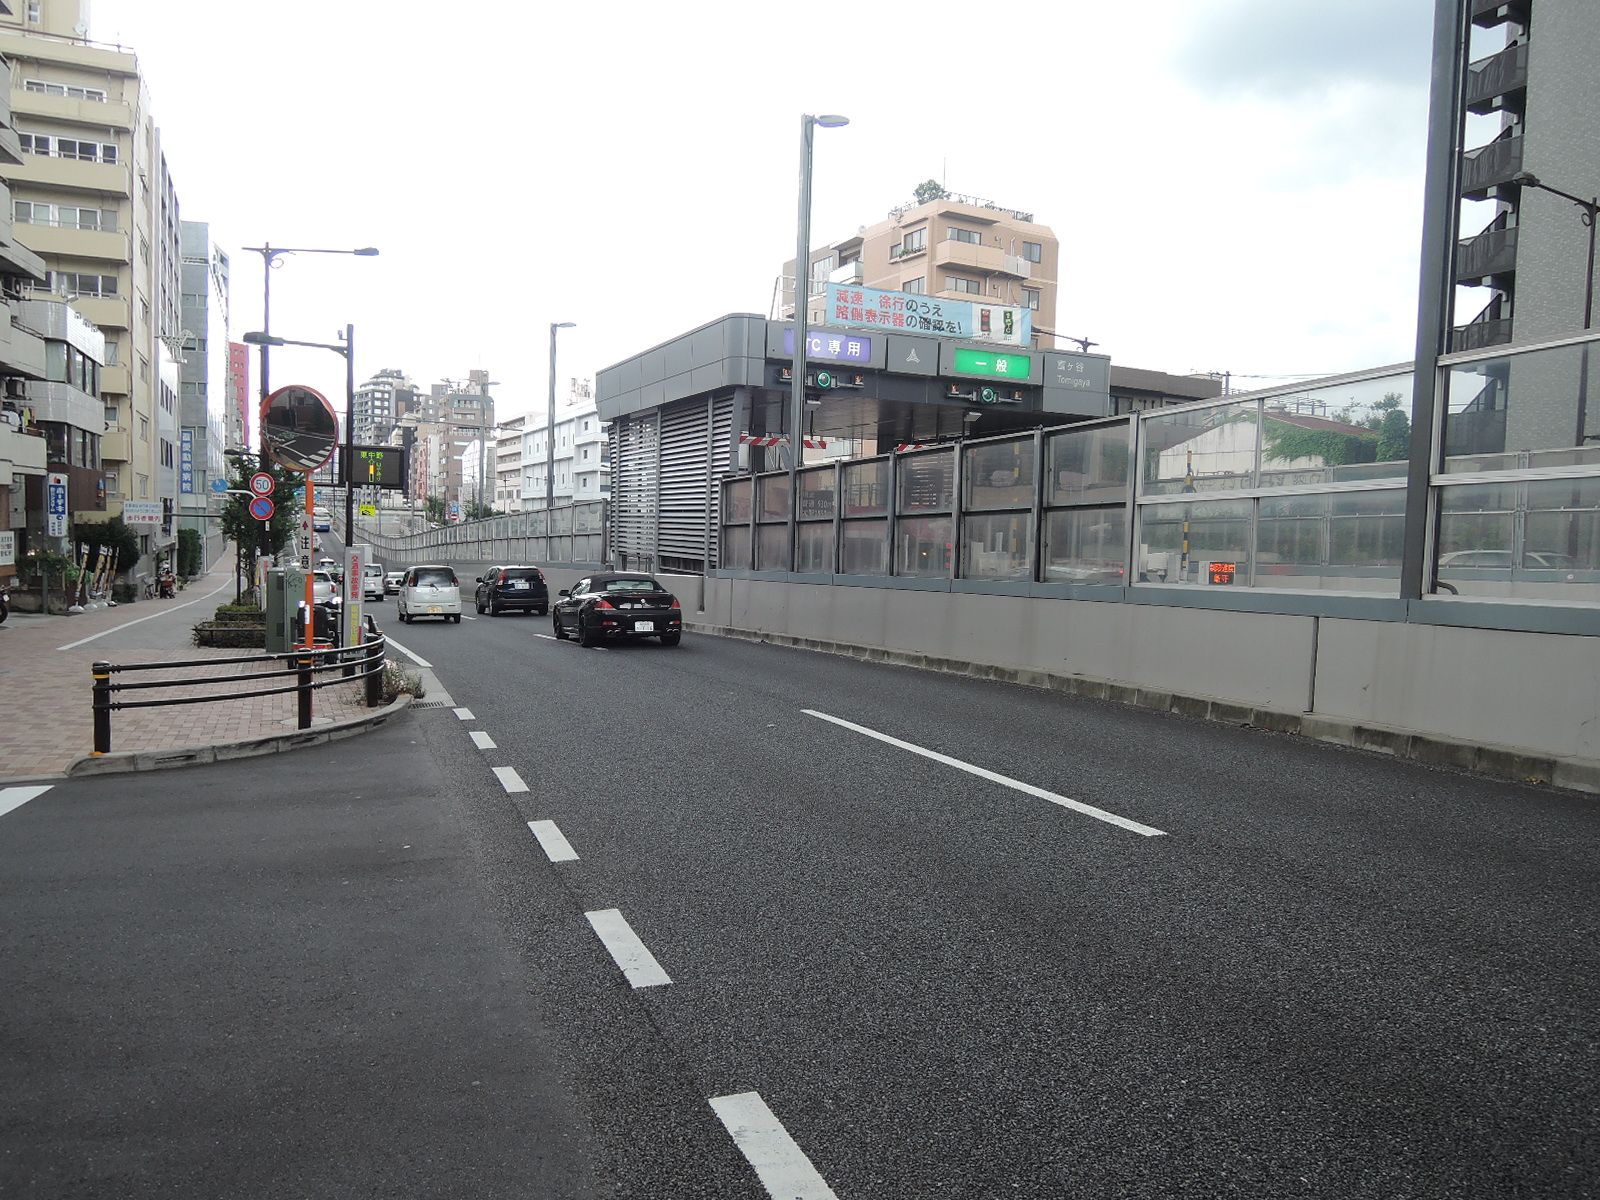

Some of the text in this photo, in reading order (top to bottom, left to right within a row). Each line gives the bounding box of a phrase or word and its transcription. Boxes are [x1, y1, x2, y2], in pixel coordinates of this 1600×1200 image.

[836, 288, 943, 318] 減速・徐行のうえ
[828, 339, 861, 357] 専用
[975, 359, 1008, 373] 一般
[1056, 374, 1091, 388] Tomigaya
[256, 480, 269, 490] 50
[301, 535, 310, 570] 注意
